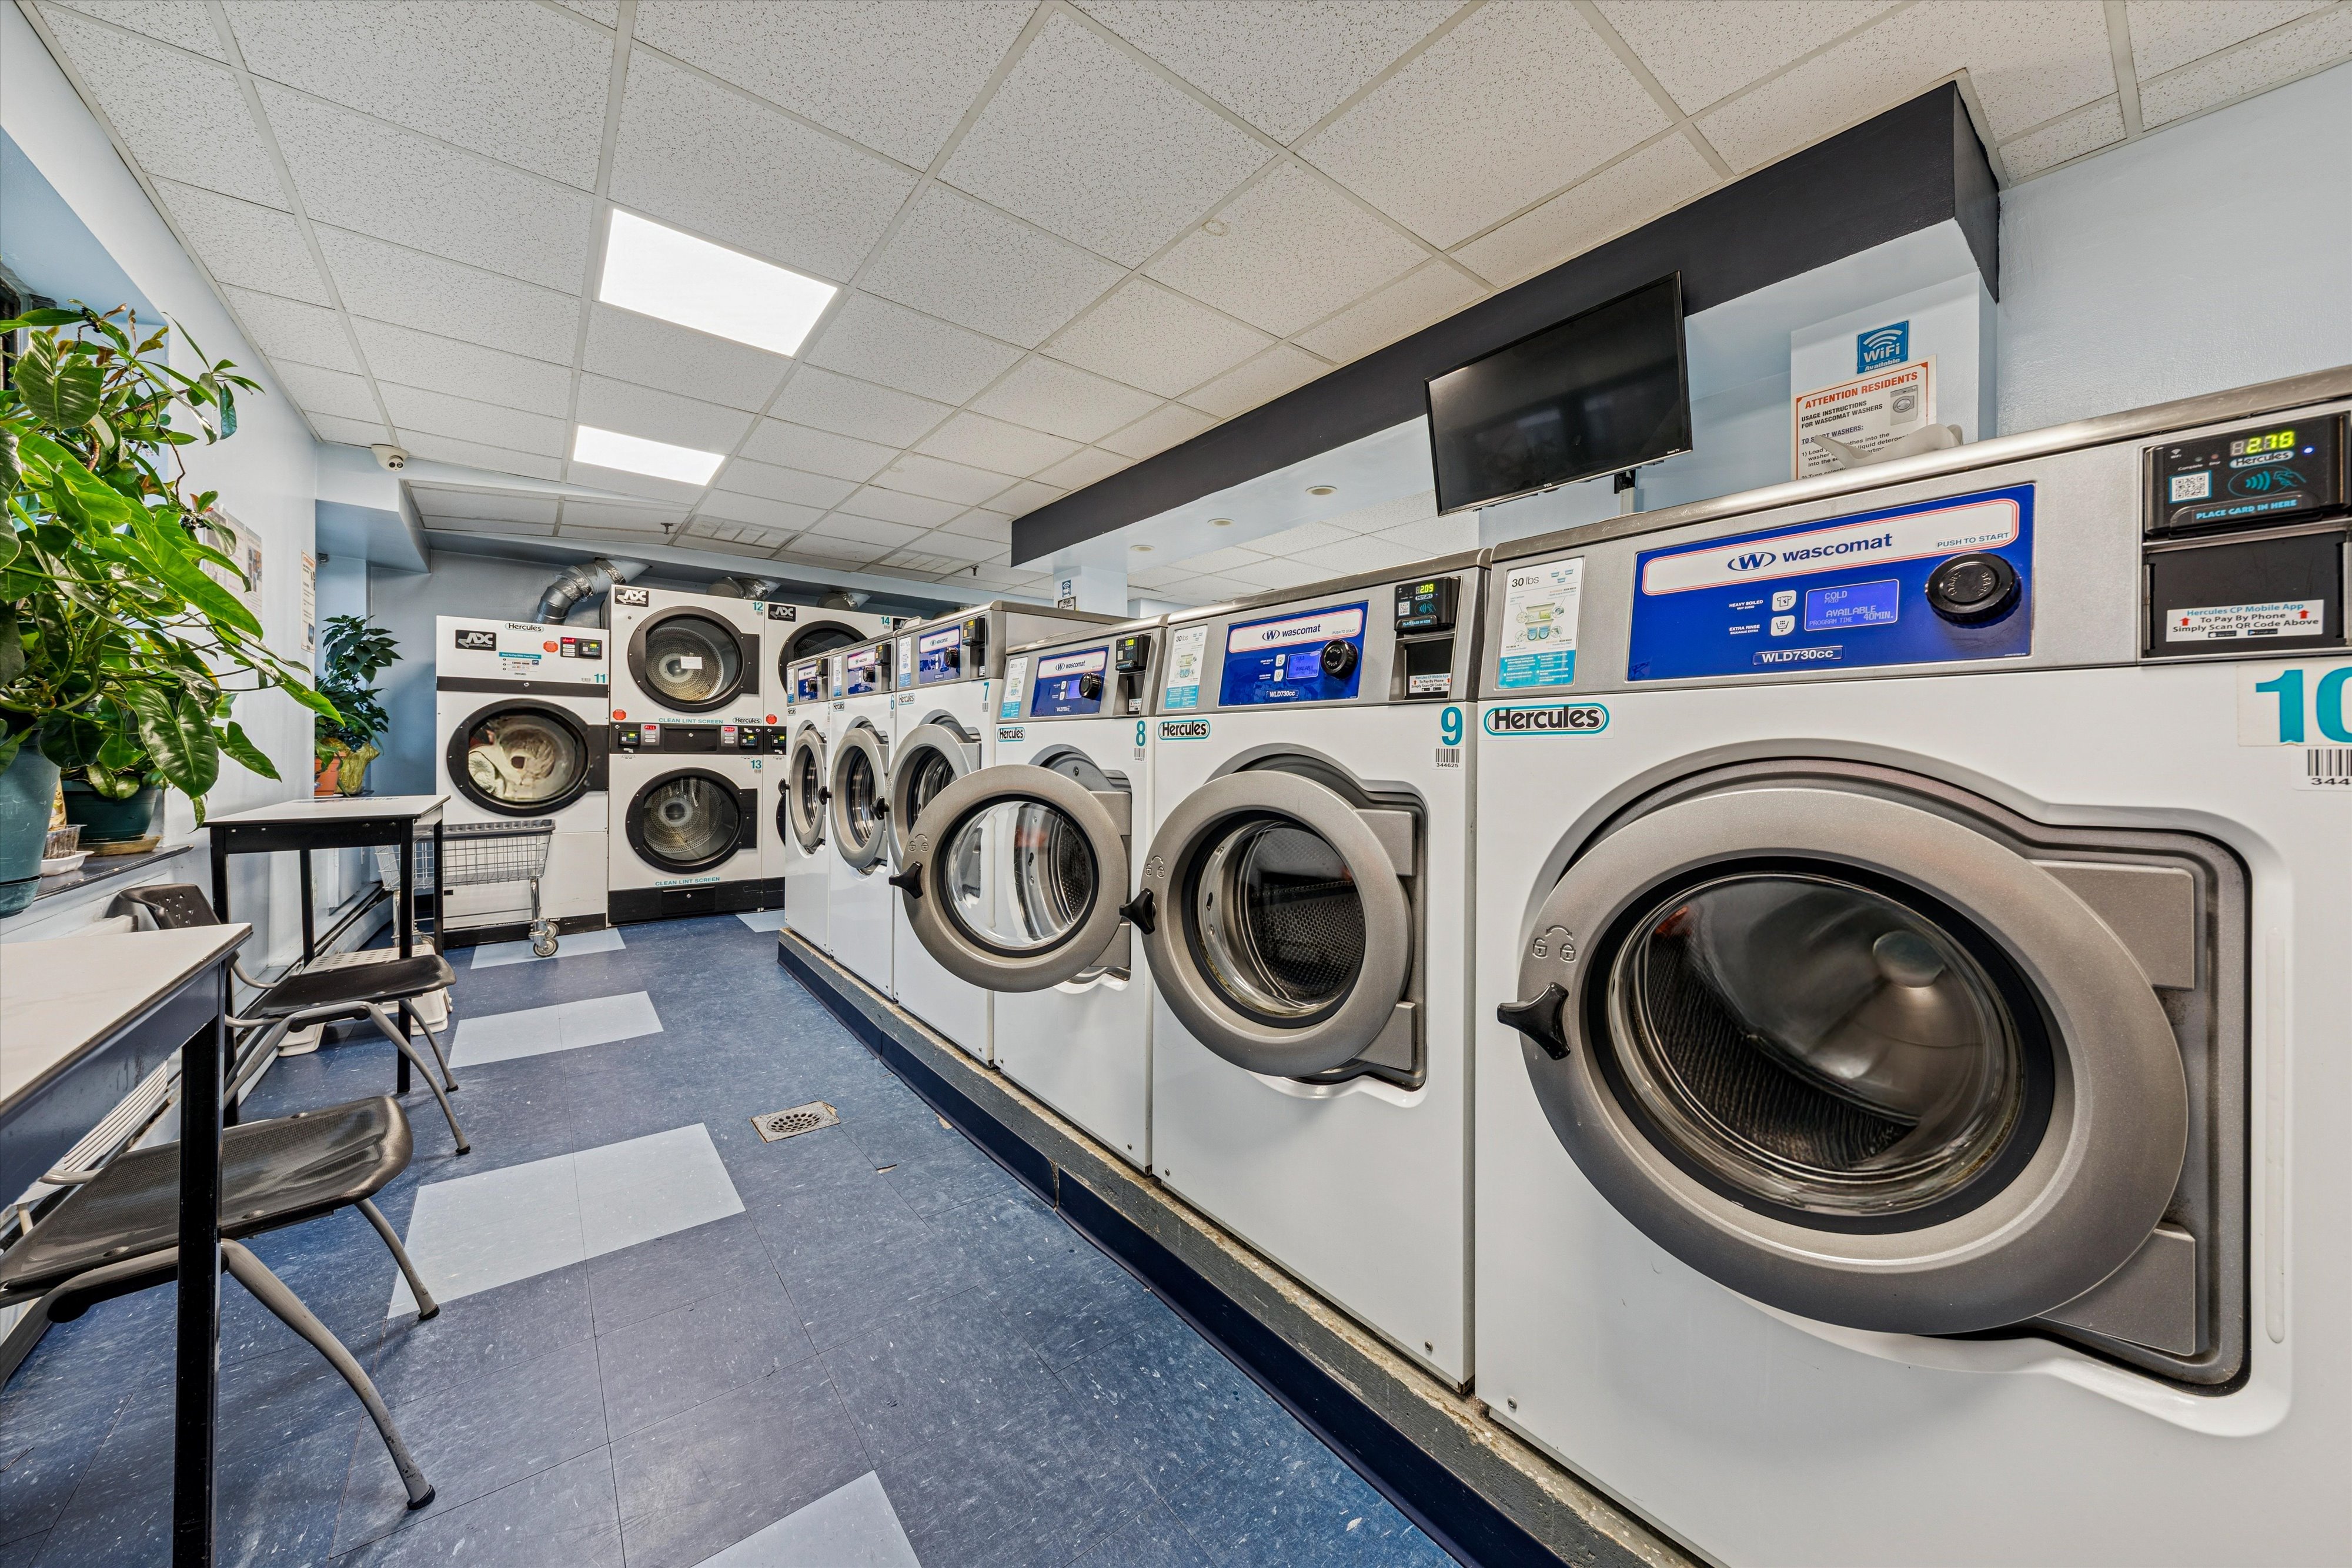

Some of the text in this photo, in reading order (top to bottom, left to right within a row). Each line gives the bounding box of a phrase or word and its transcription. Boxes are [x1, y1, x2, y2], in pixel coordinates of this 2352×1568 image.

[1863, 343, 1900, 363] WiFi
[1865, 358, 1900, 372] Available
[1805, 372, 1918, 409] ATTENTION RESIDENTS
[1801, 400, 1867, 422] USAGE INSTRUCTIONS
[1801, 403, 1883, 429] FOR WASCOMAT WASHERS
[1810, 433, 1830, 442] SRT
[1831, 425, 1864, 437] WASHERS:
[1808, 453, 1830, 462] washer
[2236, 452, 2289, 466] Hercules
[2196, 509, 2227, 519] PLACE
[2228, 506, 2256, 515] CARD
[2270, 499, 2297, 509] HERE
[1937, 539, 1962, 548] PUSH
[1979, 532, 2010, 542] START
[1782, 533, 1893, 562] wascomat
[1420, 584, 1434, 593] 2.09
[1512, 576, 1539, 587] 30 lbs
[623, 590, 646, 602] ADC
[1825, 590, 1847, 600] COLD
[752, 602, 763, 611] 12
[775, 606, 794, 617] ADC
[1826, 605, 1877, 617] AVAILABLE
[2187, 608, 2229, 617] Hercules
[2245, 604, 2281, 613] Mobile
[2282, 603, 2304, 611] App
[881, 617, 890, 625] 14
[1863, 611, 1894, 620] 40MIN.
[508, 623, 542, 632] Hercules
[1282, 624, 1321, 637] wascomat
[2173, 626, 2206, 634] Simply
[2283, 618, 2319, 627] Above
[466, 632, 493, 645] ADC
[1762, 649, 1834, 663] WLD730cc
[1065, 660, 1085, 668] wascomat
[594, 674, 606, 684] 11
[898, 694, 914, 703] Hercules
[983, 682, 990, 701] 7
[890, 694, 894, 710] 6
[2256, 666, 2352, 743] 10
[1494, 705, 1599, 730] Hercules
[999, 727, 1023, 739] Hercules
[1162, 721, 1207, 737] Hercules
[1441, 706, 1463, 746] 9
[1136, 720, 1146, 747] 8
[750, 760, 762, 769] 13
